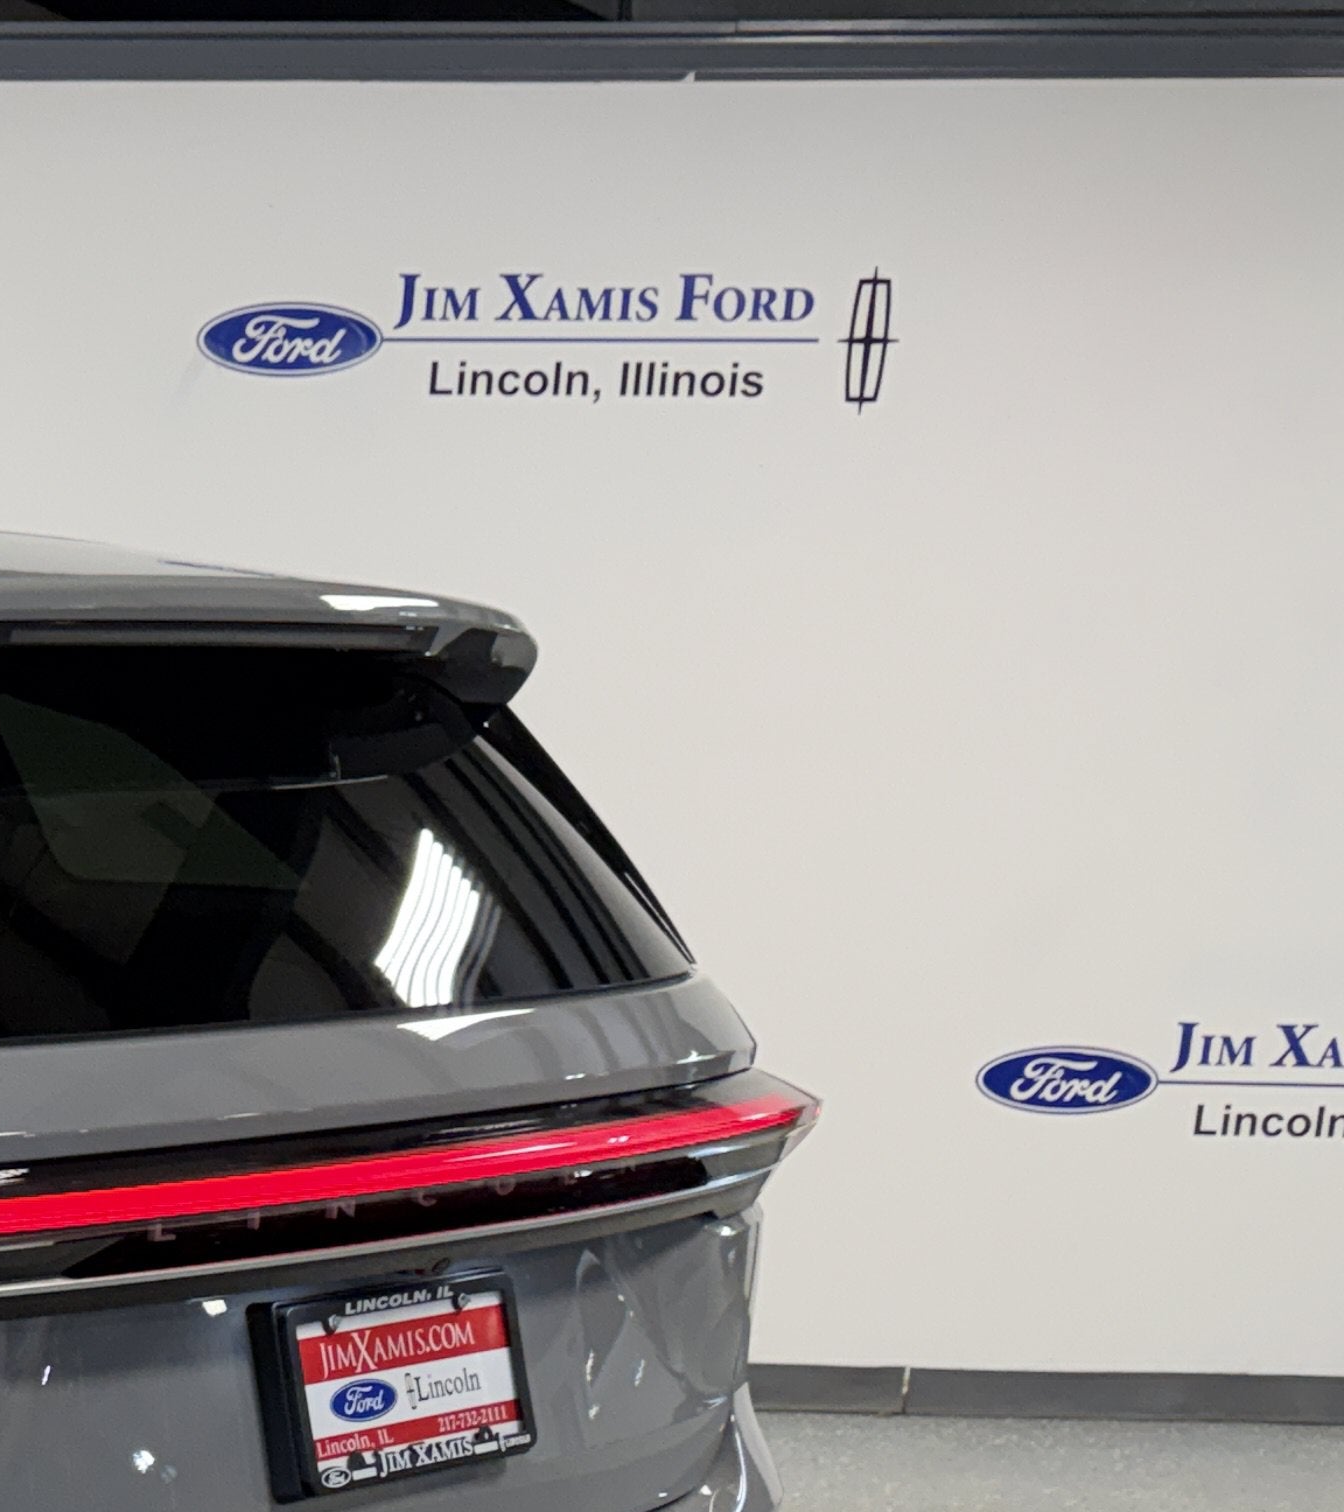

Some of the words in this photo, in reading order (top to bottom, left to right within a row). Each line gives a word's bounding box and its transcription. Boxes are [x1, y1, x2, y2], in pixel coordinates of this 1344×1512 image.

[393, 273, 481, 330] JIM
[494, 273, 660, 322] XAMIS
[674, 274, 815, 323] FORD
[232, 315, 346, 366] Ford
[428, 360, 603, 405] Lincoln,
[619, 361, 765, 397] Illinois
[1169, 1022, 1257, 1073] JIM
[1009, 1057, 1122, 1104] Ford
[345, 1288, 431, 1315] LINCOLN,
[437, 1285, 454, 1299] IL
[344, 1386, 385, 1415] Ford
[415, 1368, 481, 1401] Lincoln
[438, 1405, 507, 1432] 217-732-2111
[315, 1434, 376, 1458] Lincoln,
[378, 1429, 394, 1445] IL
[378, 1450, 412, 1478] JIM
[415, 1437, 473, 1465] XAMIS
